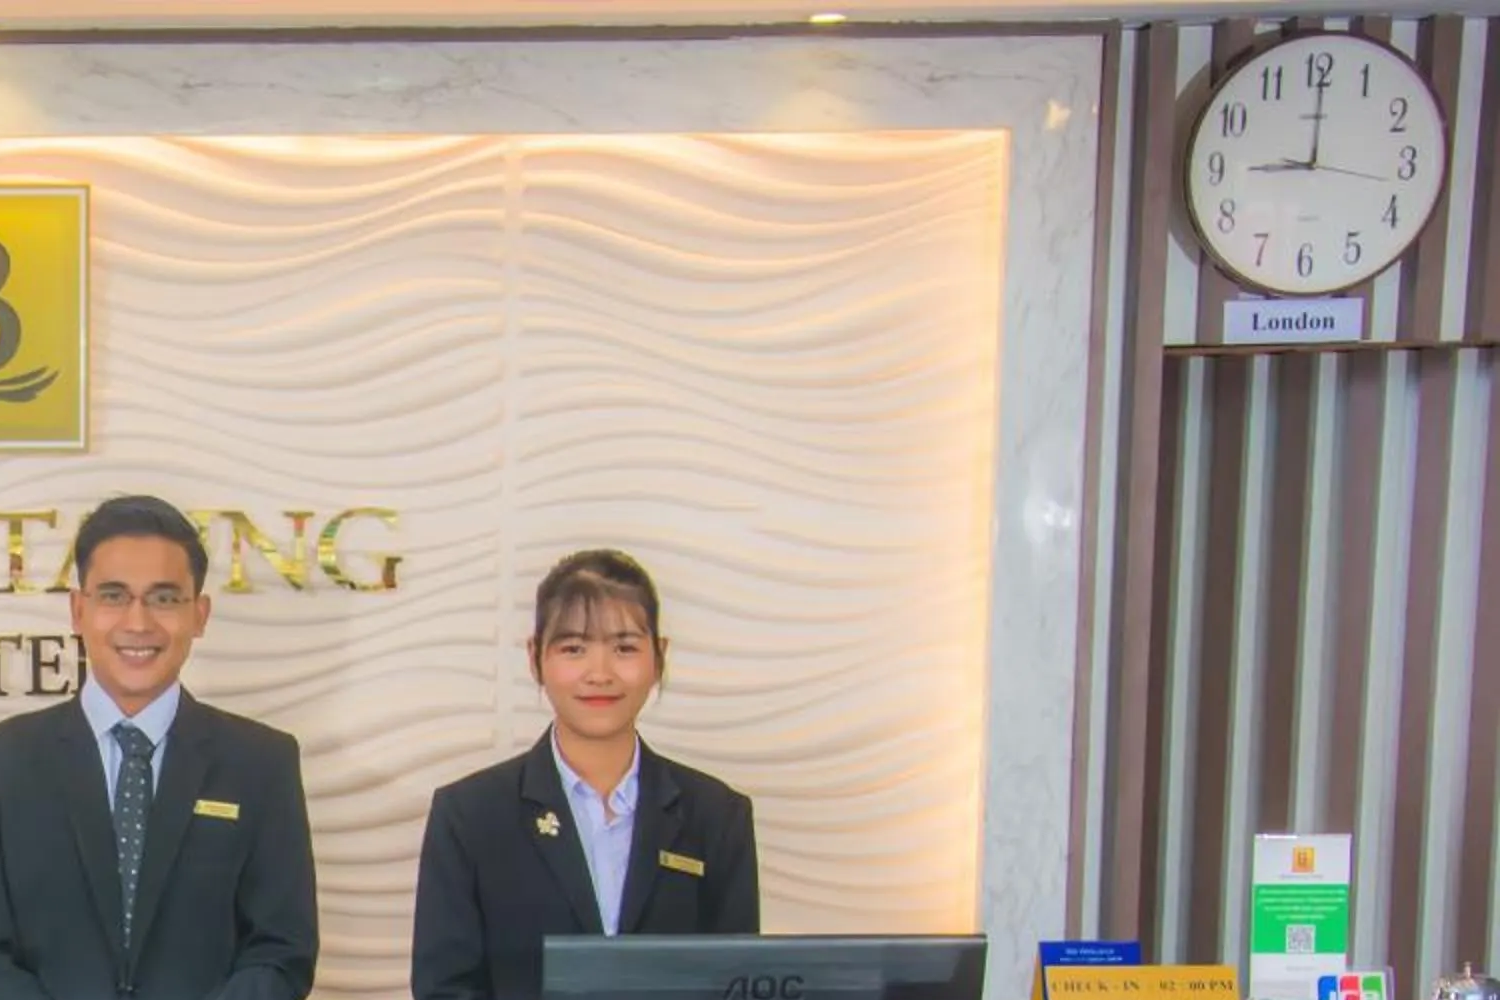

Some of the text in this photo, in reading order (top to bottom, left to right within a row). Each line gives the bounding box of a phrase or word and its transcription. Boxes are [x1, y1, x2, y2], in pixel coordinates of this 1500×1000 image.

[1261, 65, 1284, 101] 11
[1304, 52, 1334, 88] 12
[1359, 63, 1370, 98] 1
[1220, 101, 1248, 138] 10
[1388, 97, 1409, 133] 2
[1208, 152, 1226, 186] 9
[1396, 145, 1418, 181] 3
[1217, 199, 1236, 234] 8
[1381, 194, 1399, 229] 4
[1252, 233, 1270, 267] 7
[1297, 243, 1314, 278] 6
[1343, 232, 1361, 265] 5
[1252, 311, 1336, 331] London
